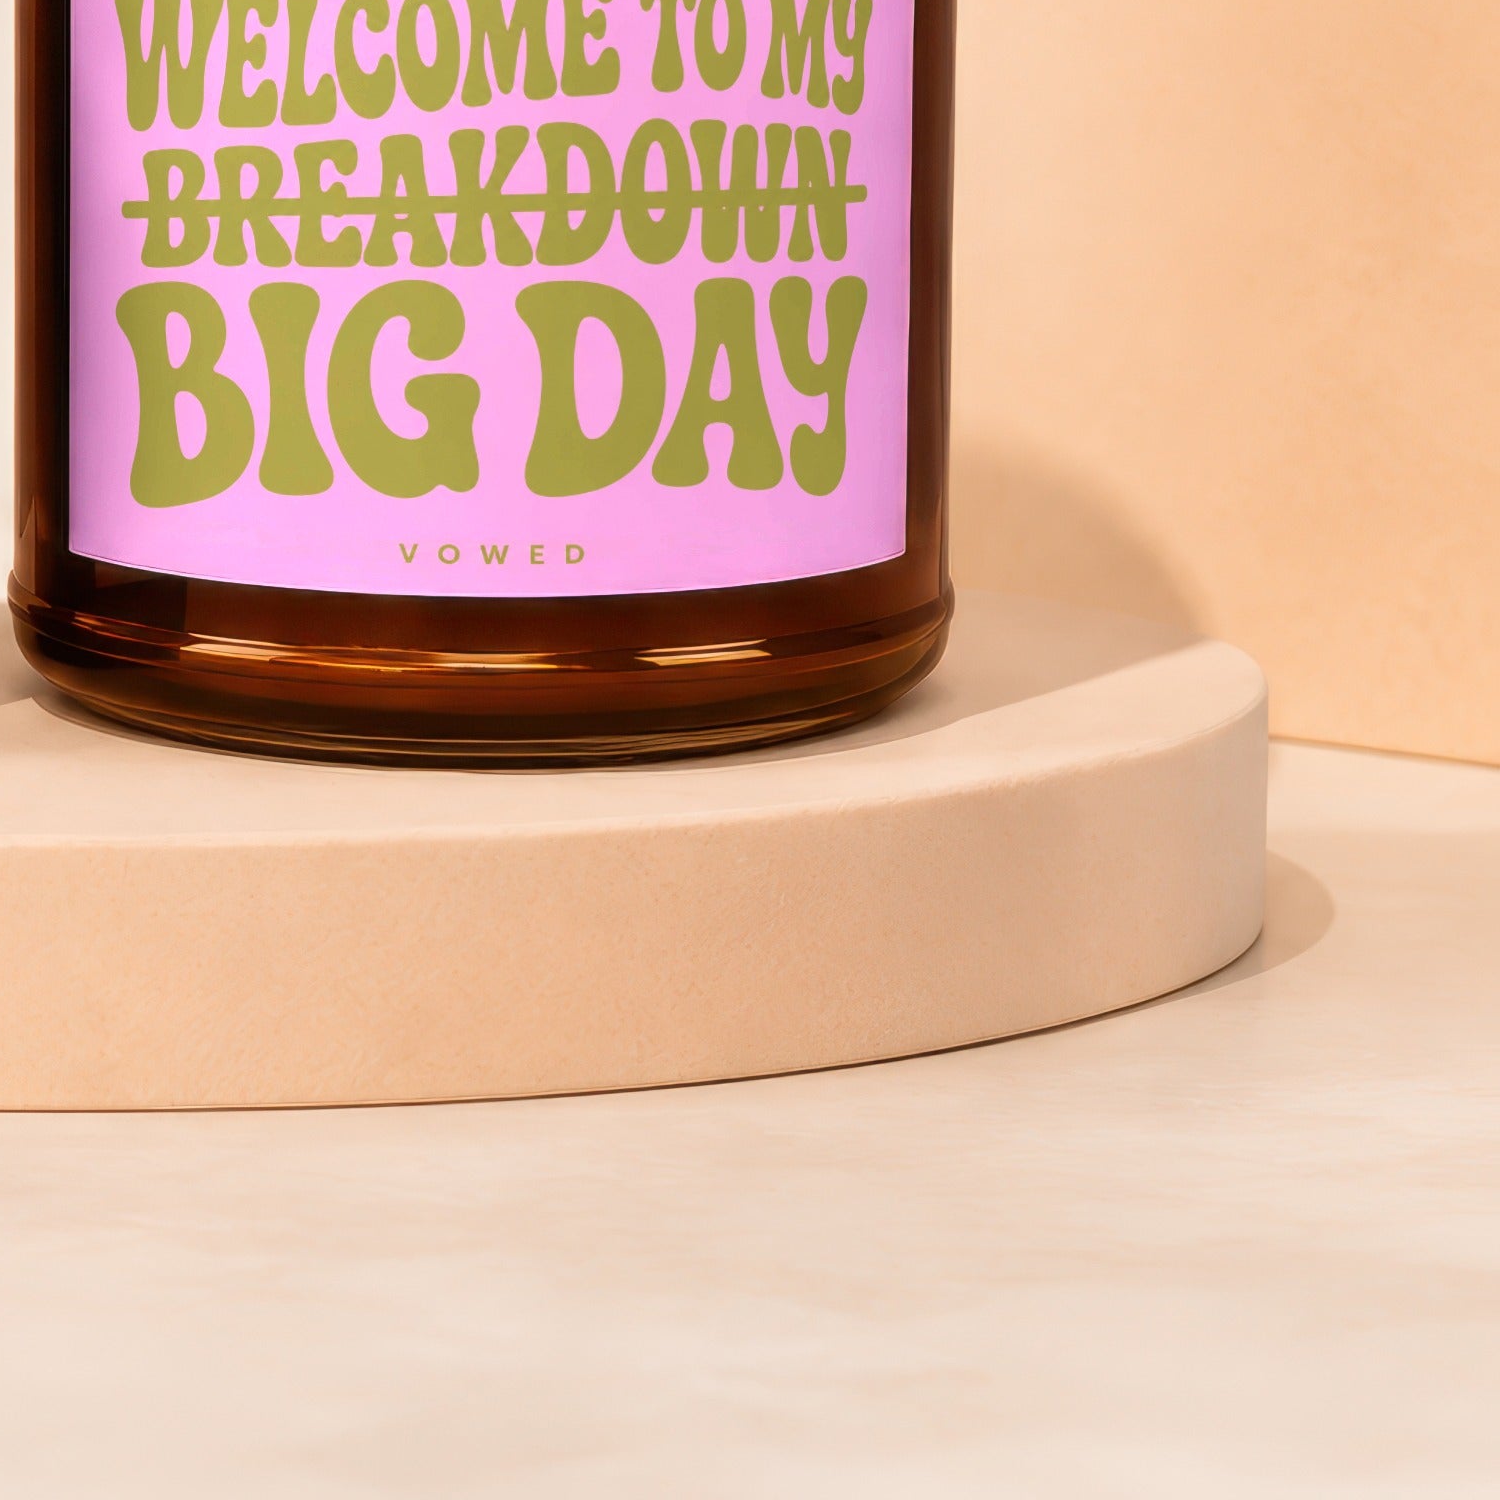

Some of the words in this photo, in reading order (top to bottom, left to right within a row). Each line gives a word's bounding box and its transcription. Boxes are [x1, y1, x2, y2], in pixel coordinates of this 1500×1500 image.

[140, 117, 850, 269] BREAKDOWN
[115, 279, 481, 509] BIG
[515, 275, 868, 498] DAY
[399, 543, 586, 565] VOWED
